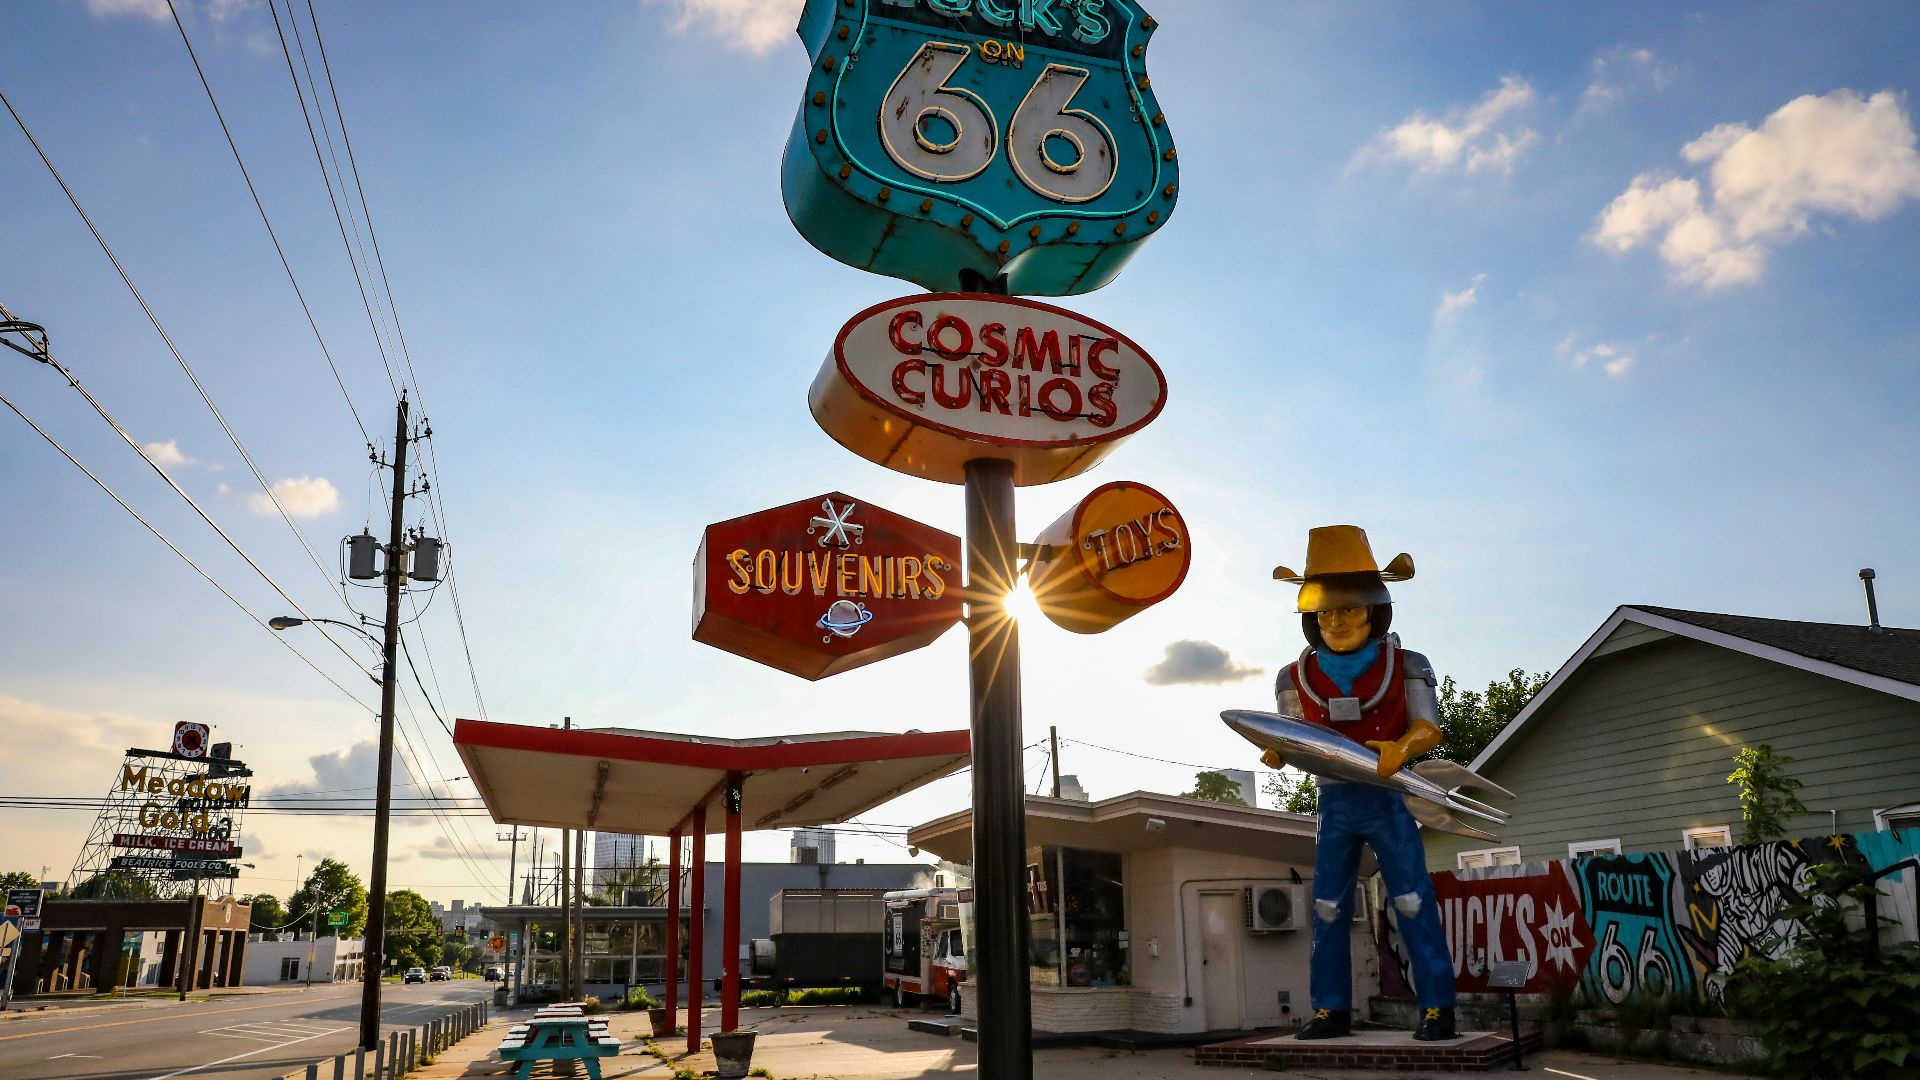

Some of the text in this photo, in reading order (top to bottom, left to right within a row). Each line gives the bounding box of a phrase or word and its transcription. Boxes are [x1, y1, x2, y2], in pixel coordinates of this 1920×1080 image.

[979, 39, 1024, 70] ON
[879, 41, 1118, 203] 66
[888, 310, 1120, 382] COSMIC
[892, 359, 1118, 428] CURIOS
[1089, 507, 1181, 572] TOYS
[727, 548, 947, 600] SOUVENIRS
[122, 765, 245, 800] Meadow
[139, 802, 209, 833] Gold
[120, 857, 172, 868] BEATRICE
[164, 838, 185, 849] ICE
[188, 840, 230, 852] CREAM
[1596, 870, 1655, 907] ROUTE
[1437, 893, 1571, 980] UCK'S ON
[1600, 922, 1673, 1004] 66
